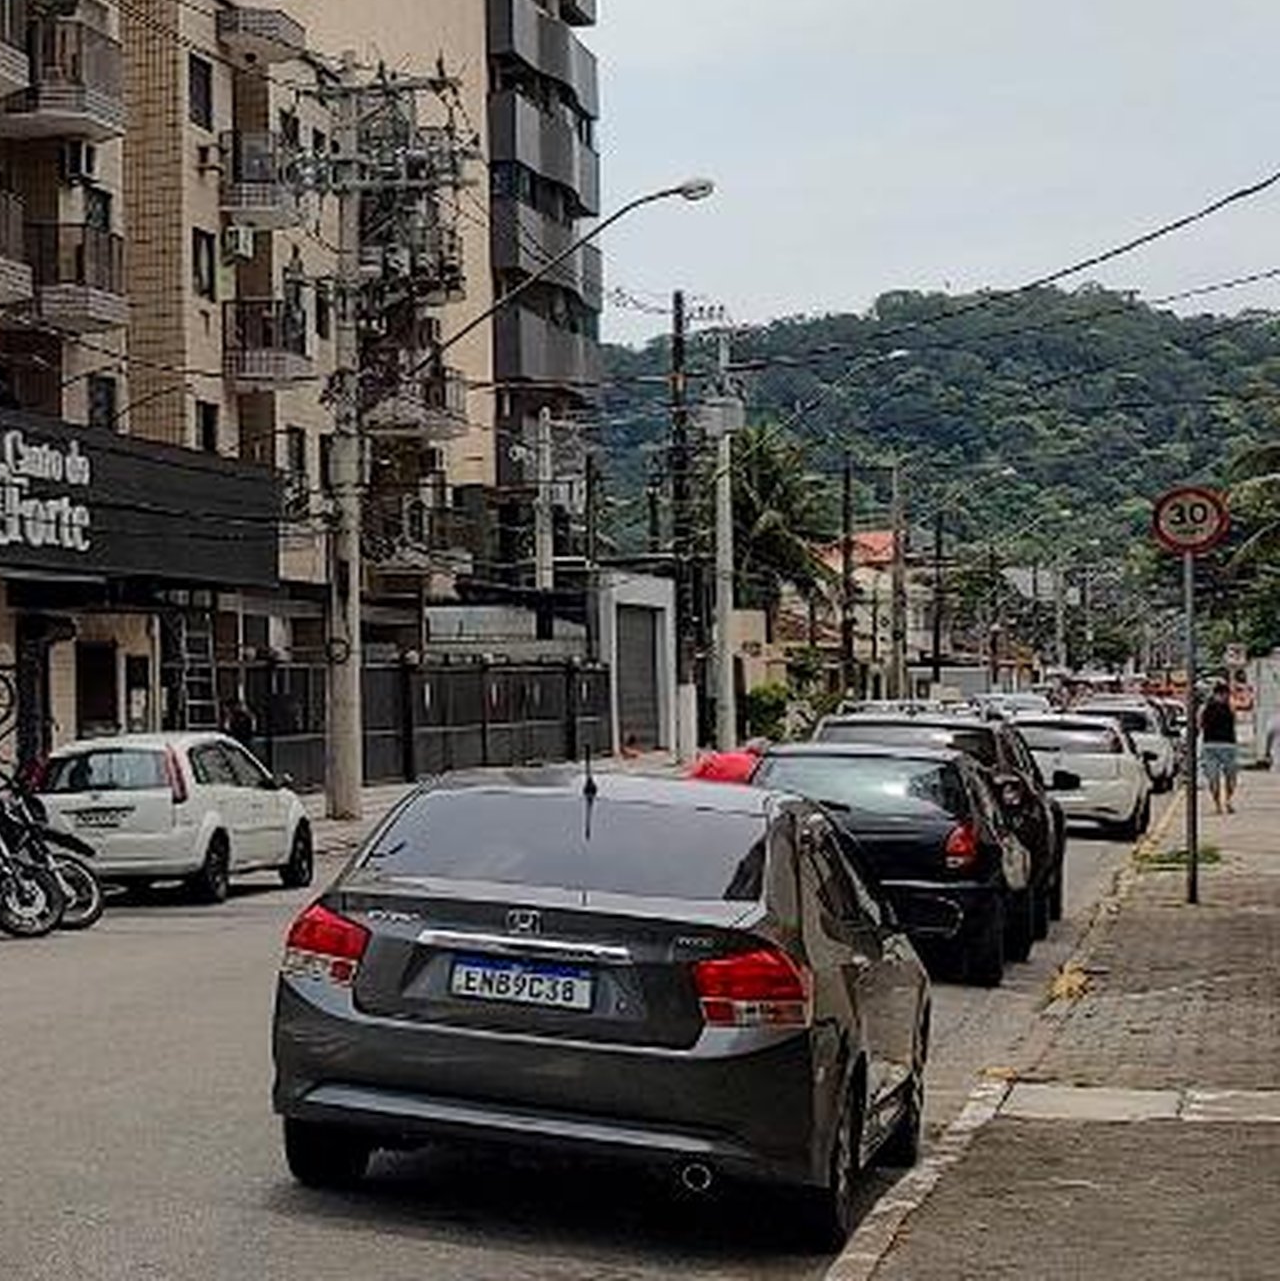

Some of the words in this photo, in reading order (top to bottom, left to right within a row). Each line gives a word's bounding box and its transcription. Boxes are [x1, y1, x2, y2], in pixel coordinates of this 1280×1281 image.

[4, 430, 64, 483] Canto
[4, 476, 92, 552] Forte
[1169, 502, 1208, 525] 30
